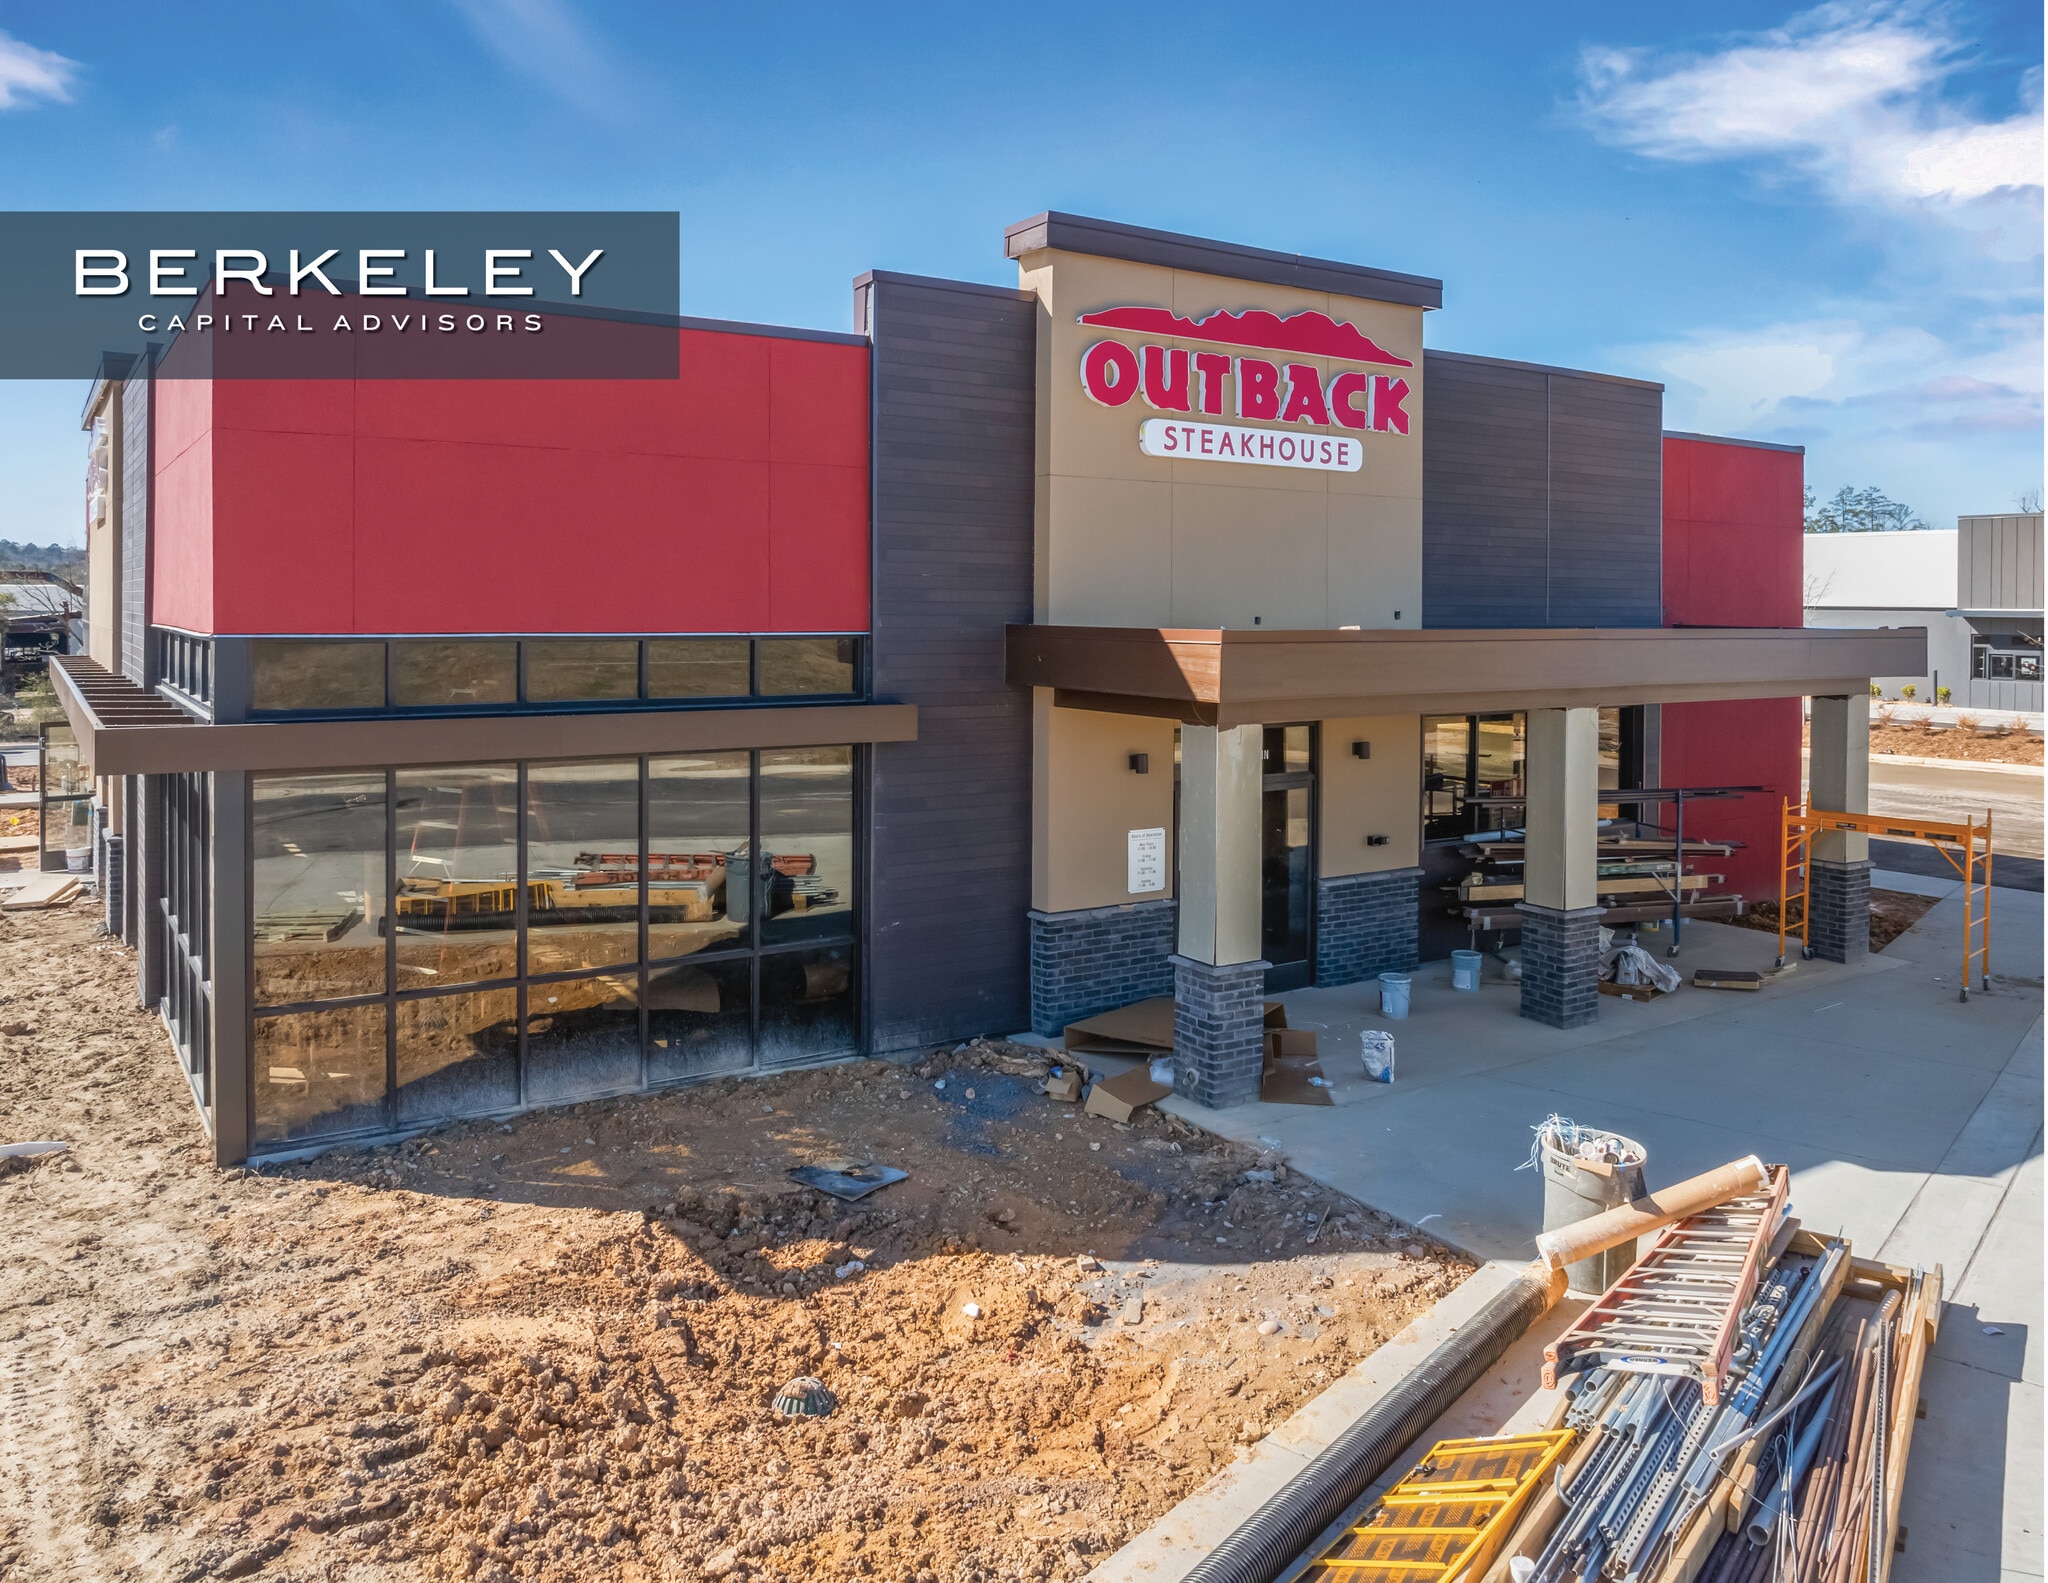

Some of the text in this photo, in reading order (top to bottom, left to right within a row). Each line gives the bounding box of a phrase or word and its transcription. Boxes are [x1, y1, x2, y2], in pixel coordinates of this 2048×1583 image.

[1080, 339, 1412, 437] OUTBACK
[1163, 425, 1350, 466] STEAKHOUSE
[1374, 1042, 1386, 1051] 45
